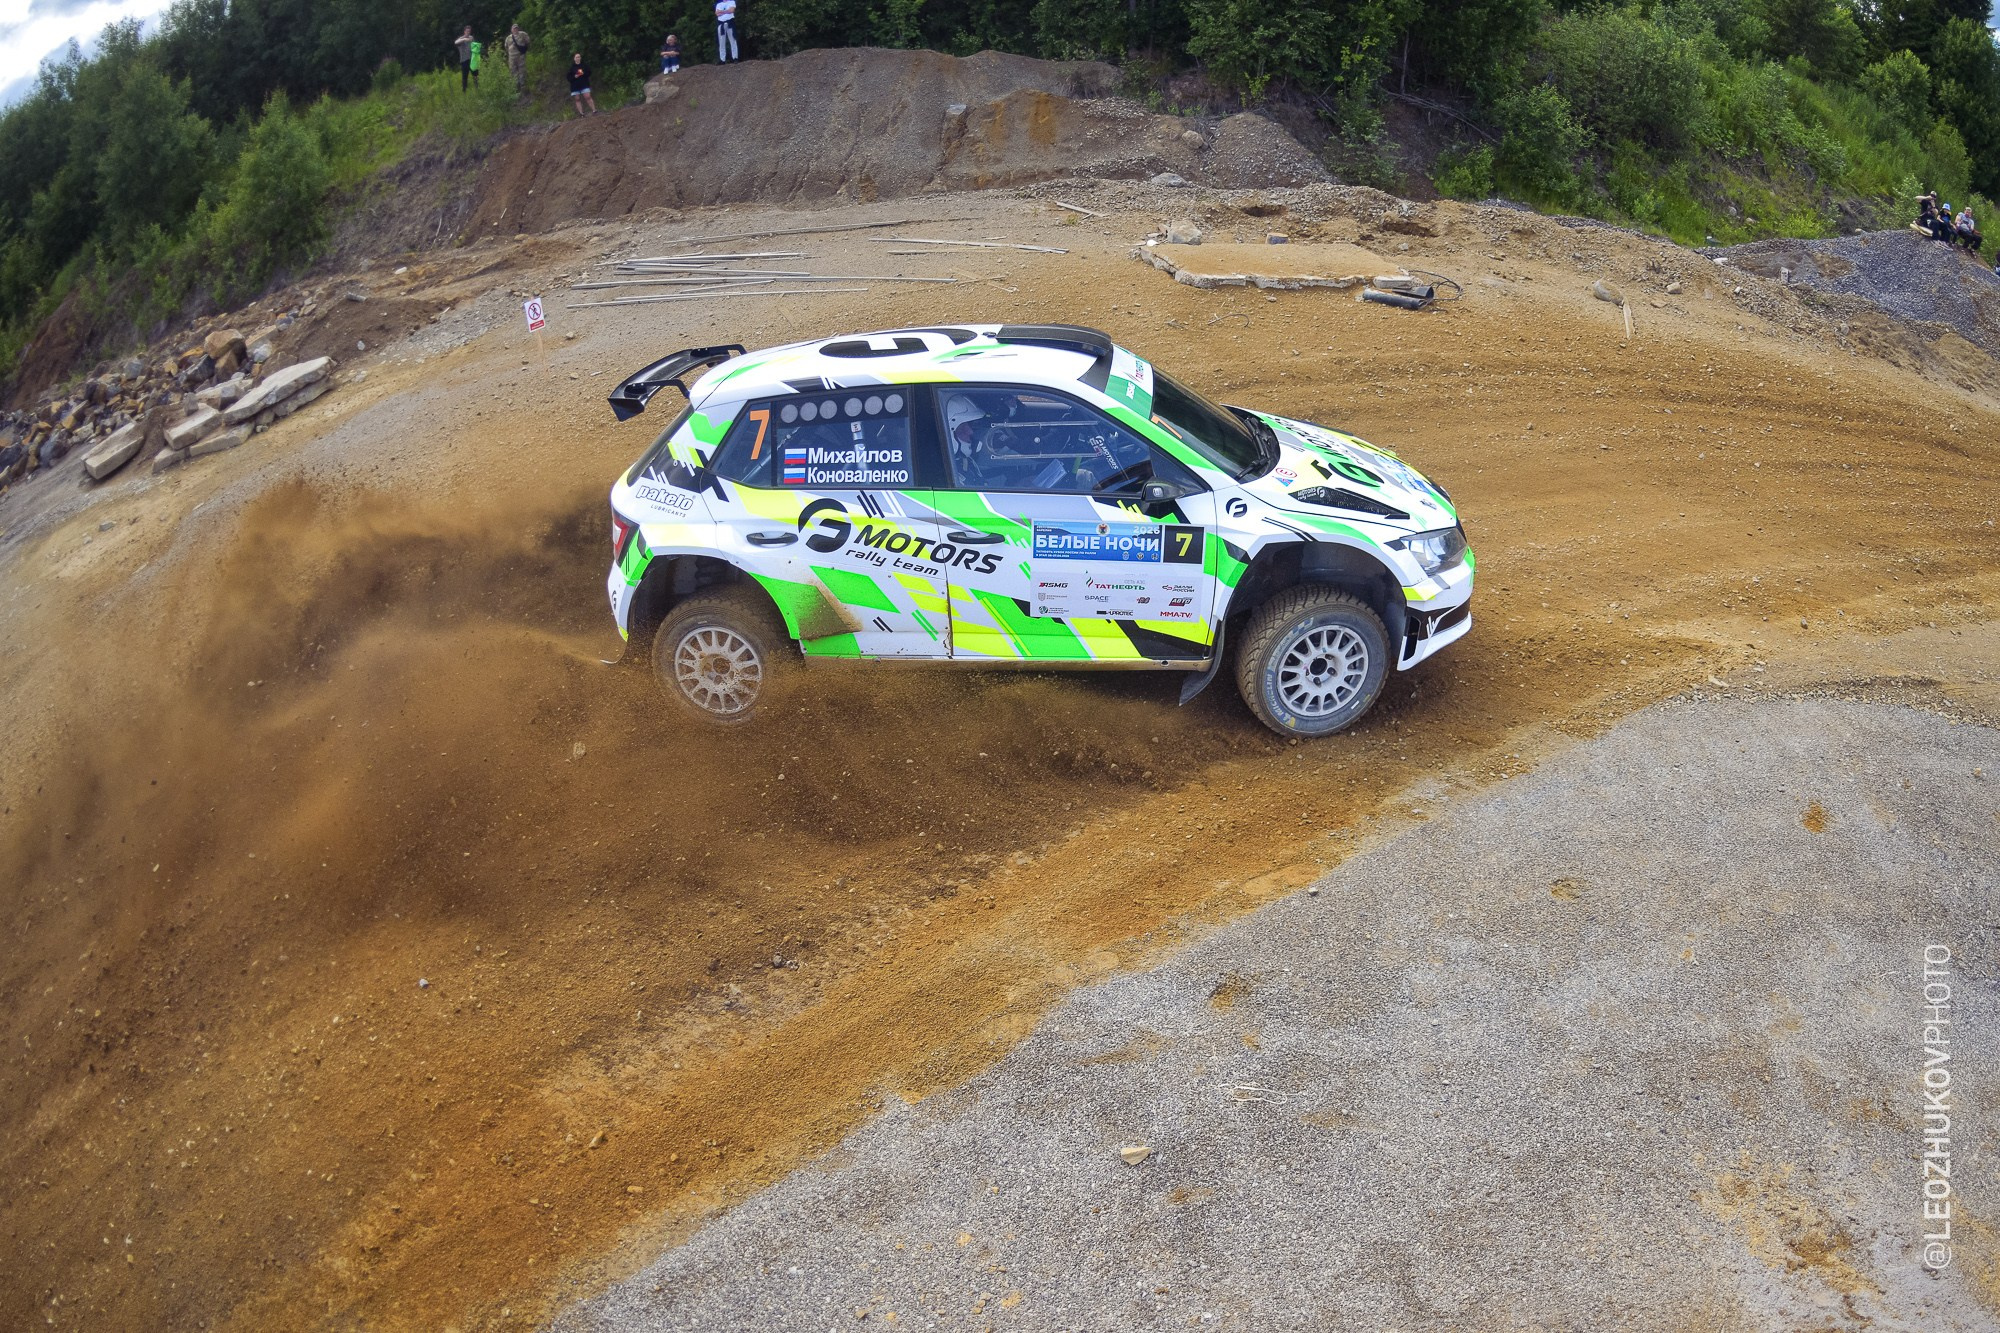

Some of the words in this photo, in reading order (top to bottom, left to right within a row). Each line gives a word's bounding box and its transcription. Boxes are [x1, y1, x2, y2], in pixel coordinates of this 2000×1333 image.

[749, 409, 770, 460] 7
[808, 446, 903, 464] Михайлов
[807, 466, 909, 484] Коноваленко
[636, 485, 694, 511] pakelo
[651, 504, 687, 518] LUBRICANTS
[853, 524, 1004, 575] MOTORS
[1036, 534, 1101, 550] БЕЛЫЕ
[1105, 536, 1160, 552] НОЧИ
[1175, 532, 1193, 557] 7
[845, 549, 888, 567] rally
[892, 557, 939, 576] team
[1095, 583, 1146, 591] ТАТНЕФТЬ
